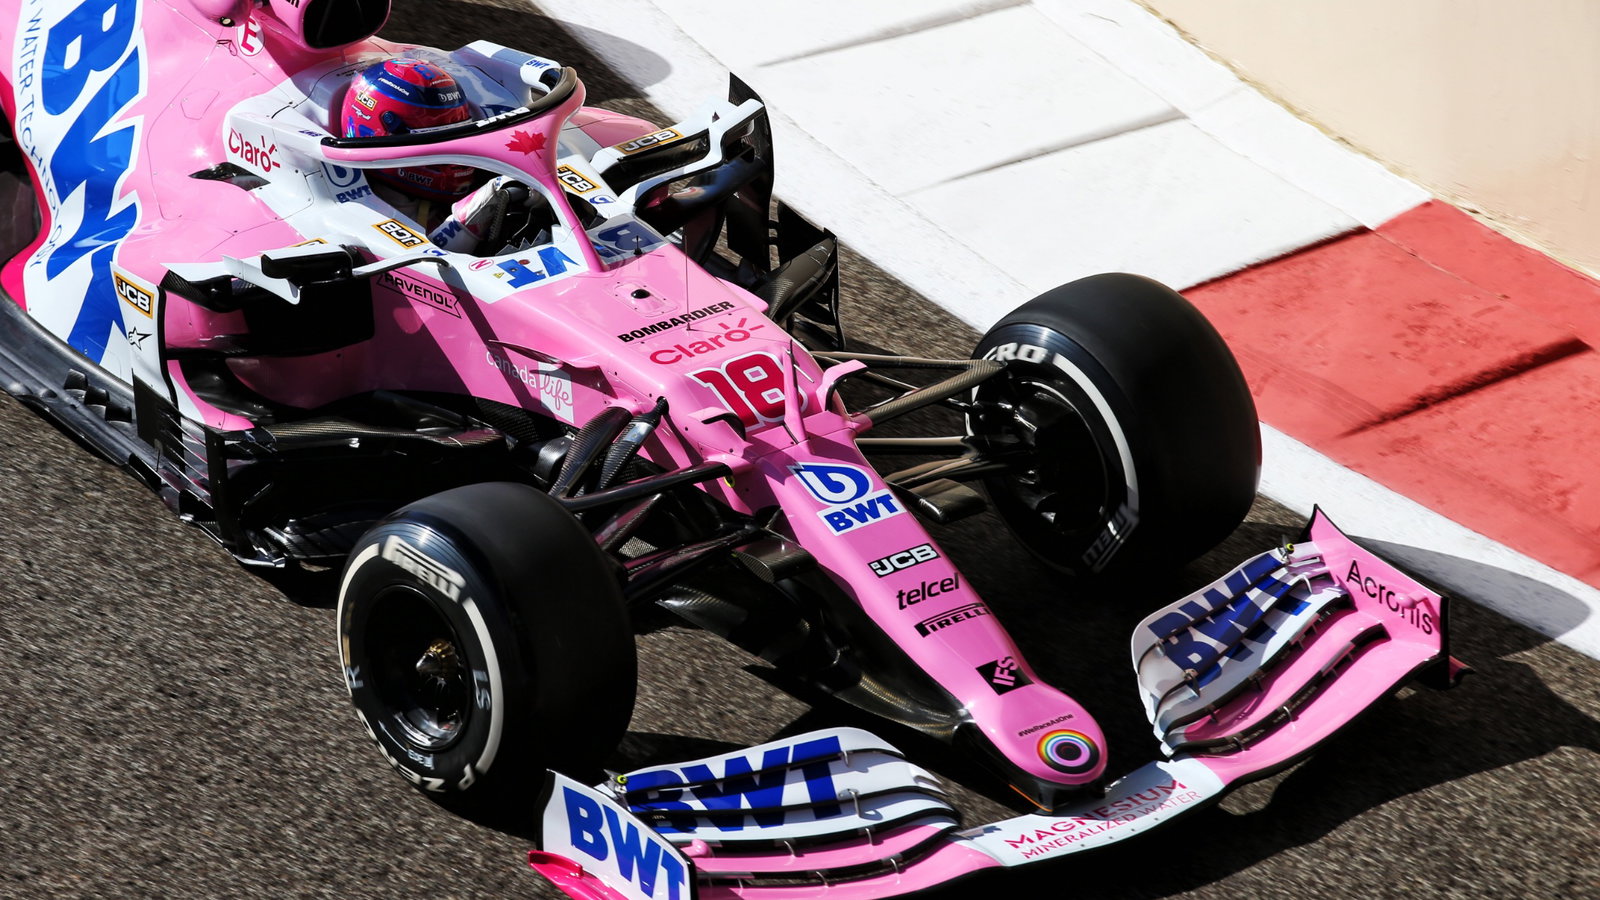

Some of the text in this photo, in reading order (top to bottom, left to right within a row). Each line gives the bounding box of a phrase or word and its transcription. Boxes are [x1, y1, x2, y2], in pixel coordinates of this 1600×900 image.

[18, 18, 42, 96] WATER
[526, 59, 550, 69] BWT
[357, 91, 375, 108] JCB
[228, 128, 276, 173] Claro
[624, 129, 676, 152] JCB
[336, 184, 372, 204] BWT
[557, 169, 594, 193] JCB
[379, 220, 422, 248] JCB
[433, 218, 461, 248] BW
[116, 280, 151, 314] JCB
[383, 271, 454, 309] RAVENOL
[617, 300, 736, 343] BOMBARDIER
[650, 320, 758, 365] Claro
[485, 350, 574, 411] canada life
[684, 350, 808, 433] 18
[823, 493, 899, 533] BWT
[381, 534, 467, 603] PIRELLI
[870, 544, 938, 577] JCB
[896, 573, 960, 610] telcel
[914, 602, 991, 638] PIRELLI
[992, 655, 1020, 687] IFS
[1018, 712, 1074, 738] #WeRaceAsOne
[626, 735, 842, 834] BWT
[1004, 779, 1187, 849] MAGNESIUM
[1021, 790, 1203, 860] MINERALIZED WATER
[563, 785, 686, 900] BWT
